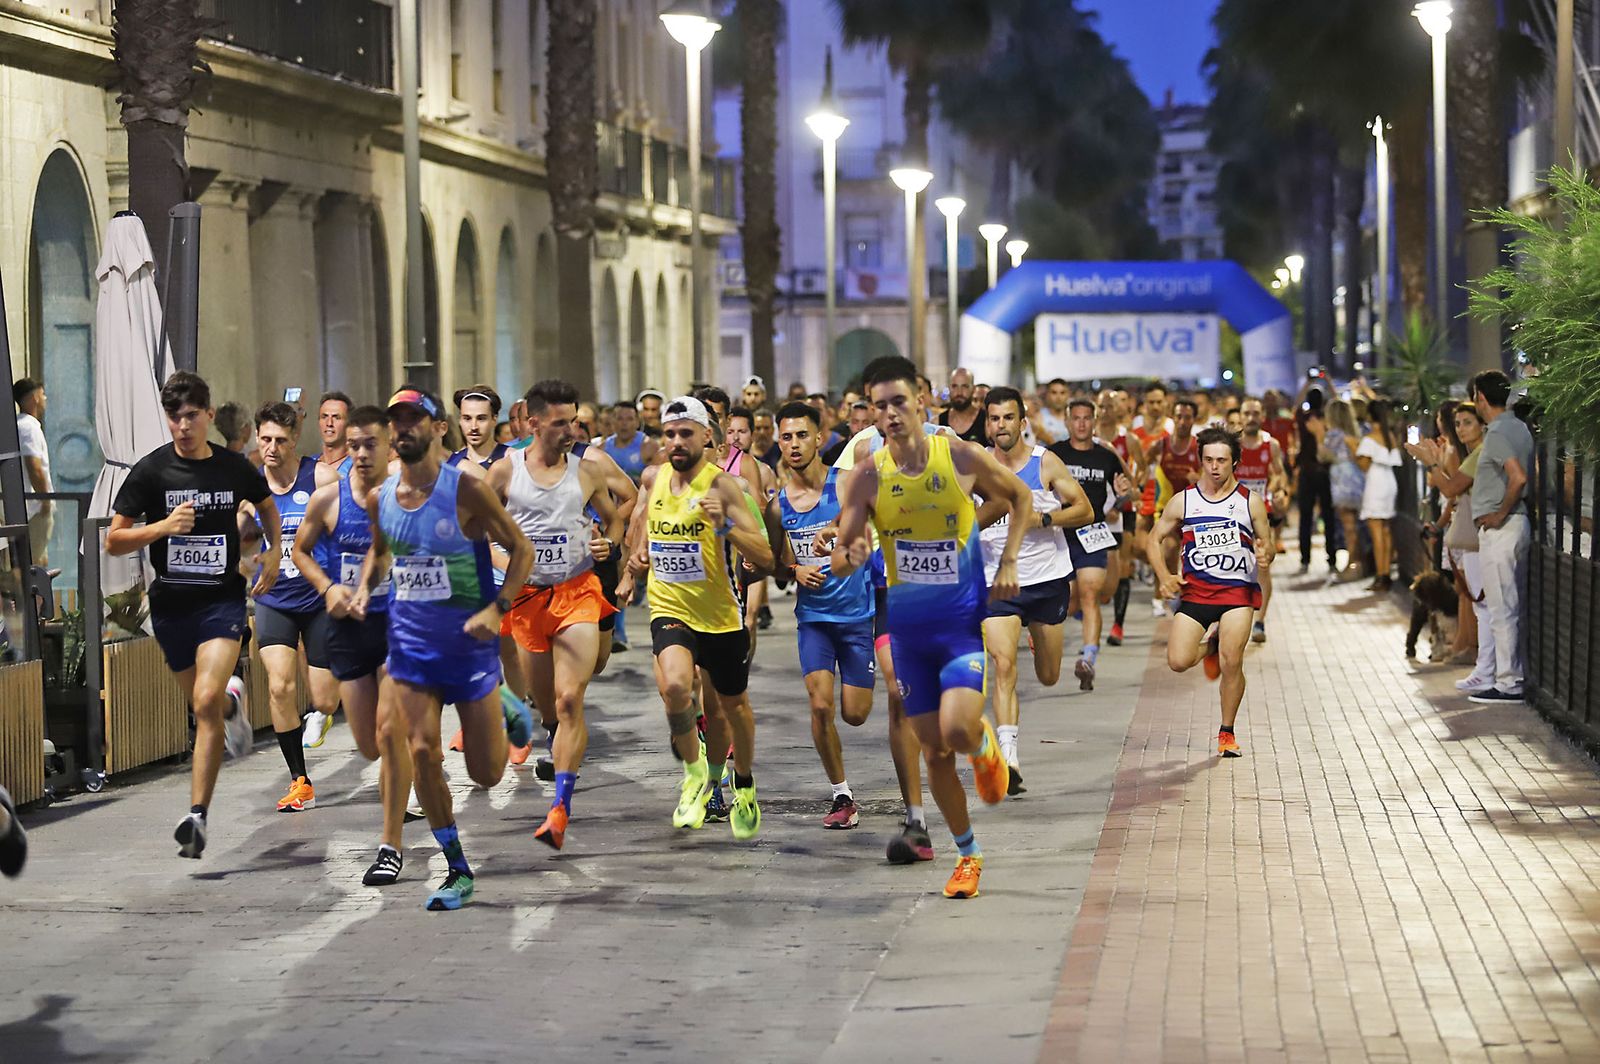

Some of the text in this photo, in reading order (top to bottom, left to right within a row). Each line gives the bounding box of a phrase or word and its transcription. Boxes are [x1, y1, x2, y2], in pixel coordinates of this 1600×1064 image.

[1044, 273, 1213, 301] Huelva original
[1049, 319, 1194, 353] Huelva
[214, 491, 233, 504] FUN
[650, 521, 705, 537] UCAMP
[1206, 532, 1228, 546] 303
[183, 549, 210, 565] 604
[661, 556, 688, 572] 655
[910, 556, 940, 573] 249
[1191, 551, 1248, 575] CODA
